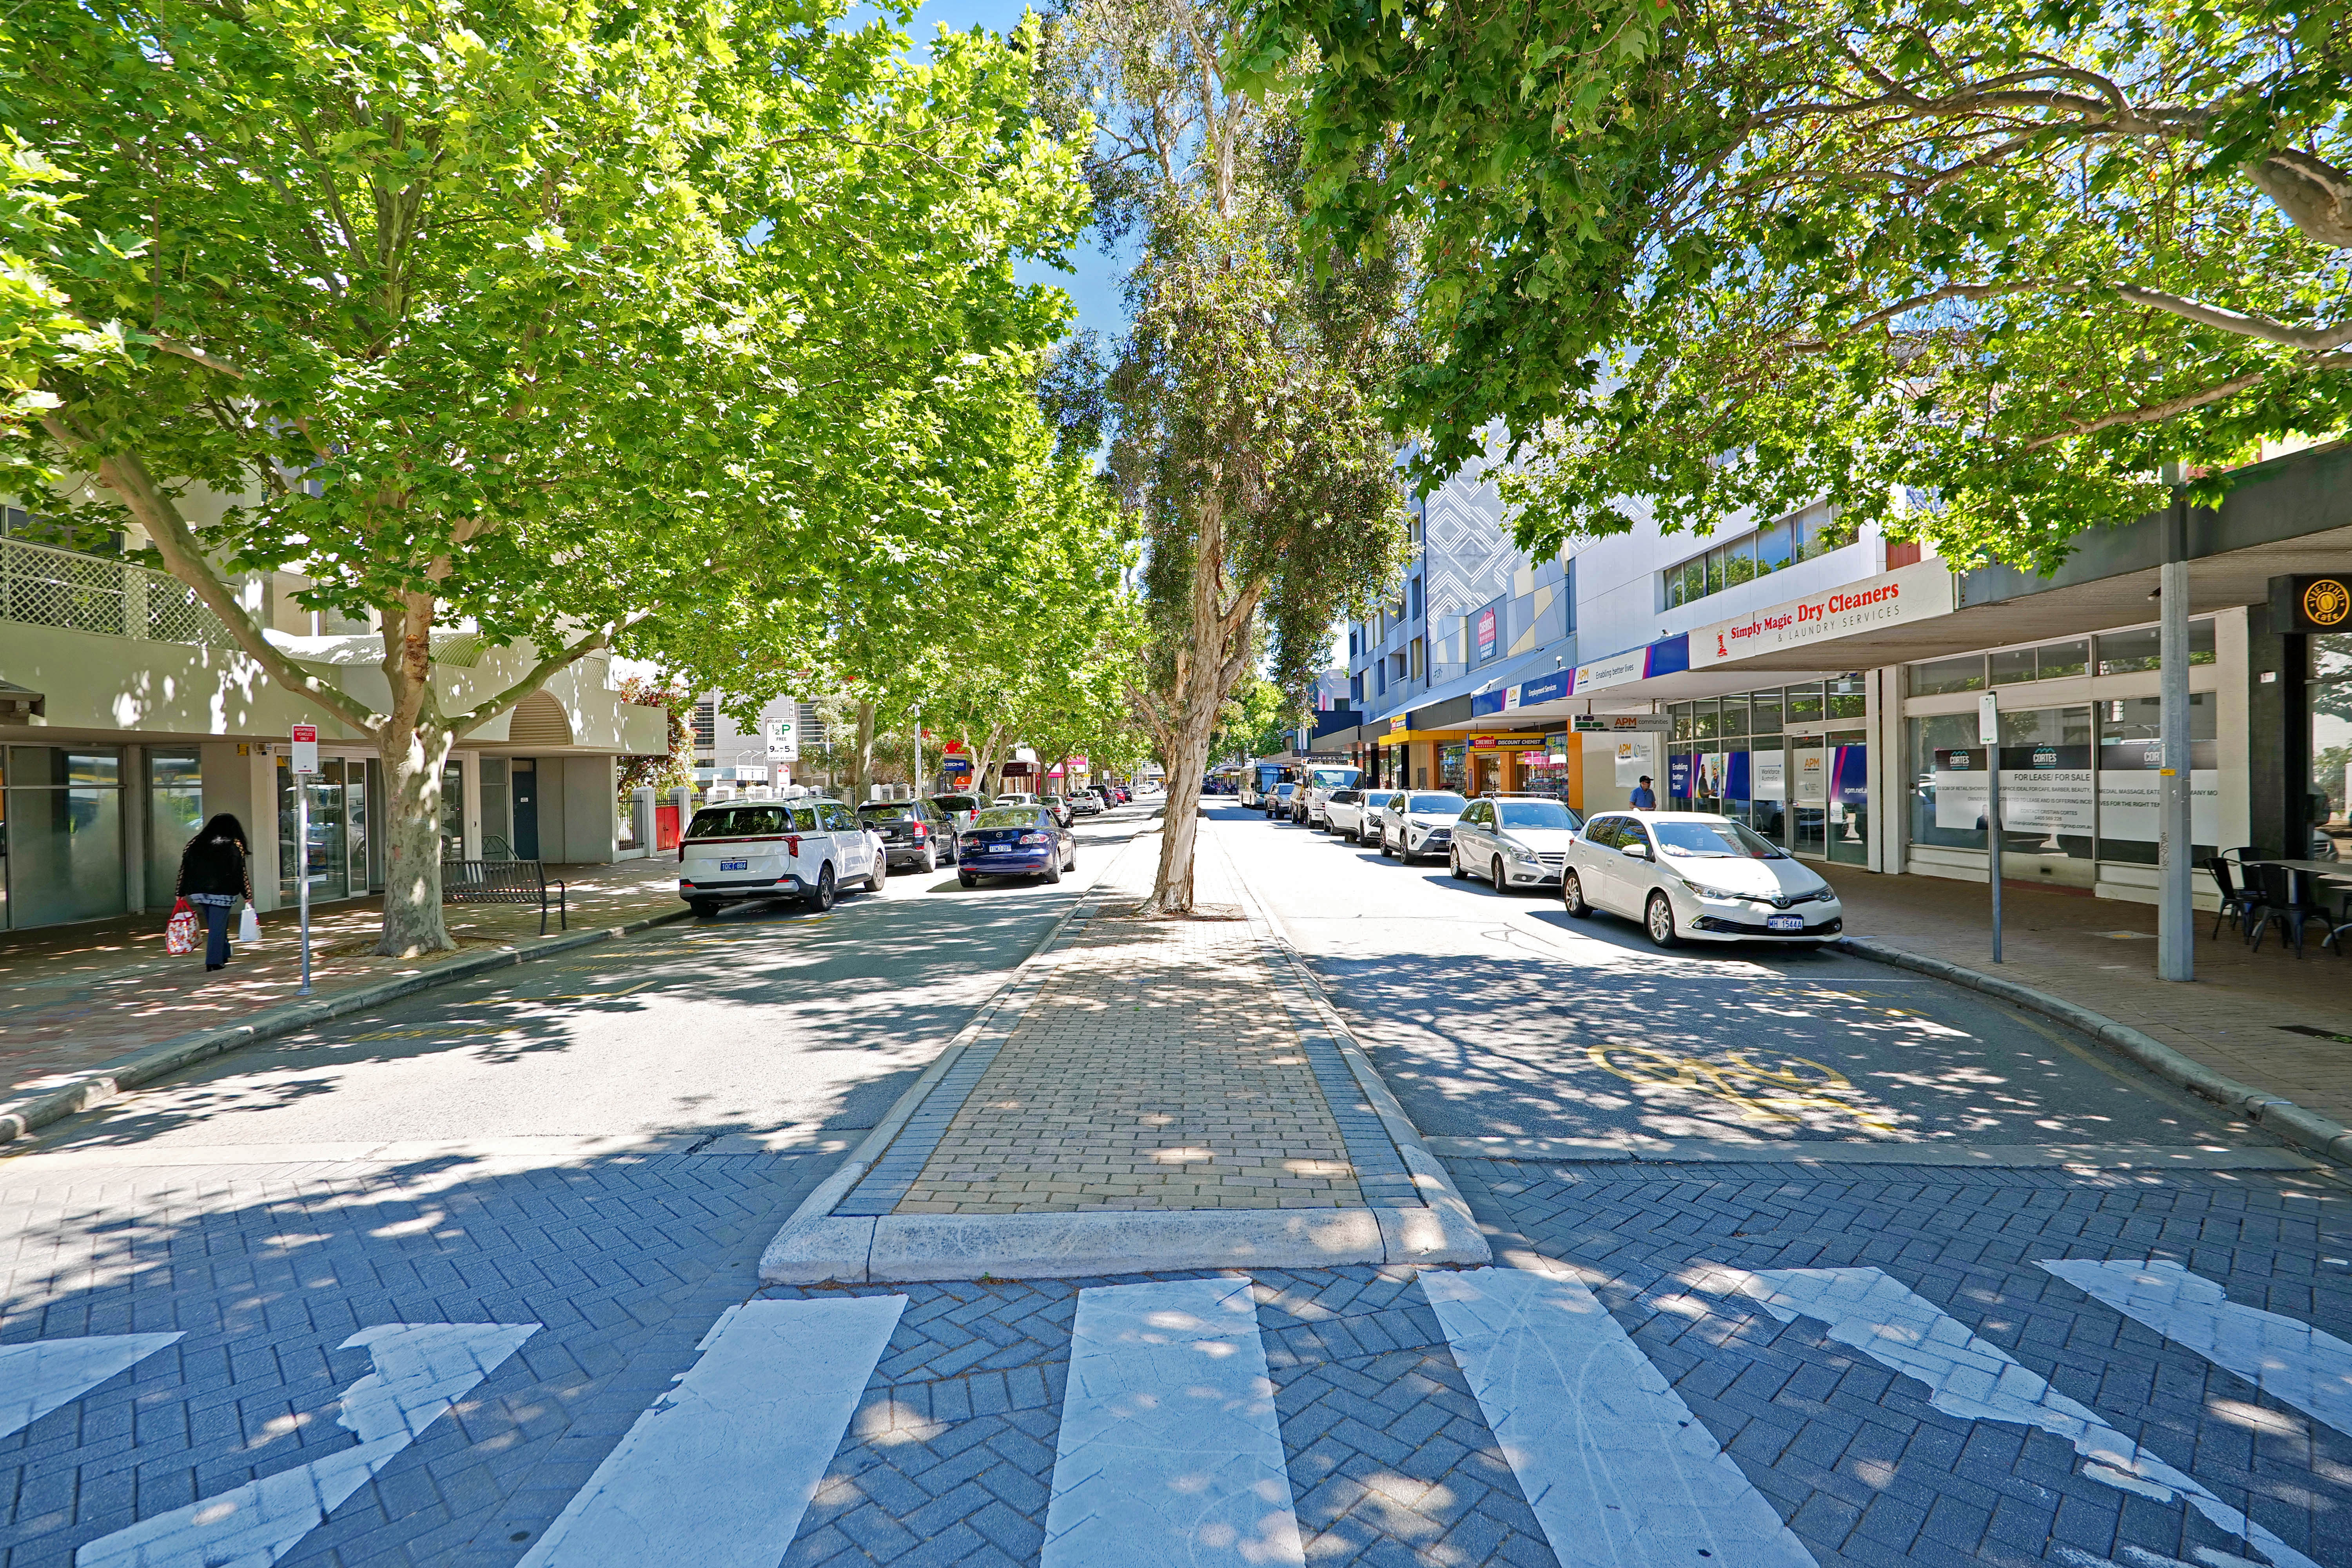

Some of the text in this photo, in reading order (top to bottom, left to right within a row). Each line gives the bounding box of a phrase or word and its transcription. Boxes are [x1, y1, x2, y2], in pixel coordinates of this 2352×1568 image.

[1731, 583, 1899, 639] Simply Magic Dry Cleaners
[2314, 611, 2340, 622] Cafe
[1479, 616, 1494, 635] CHEMIST
[1778, 605, 1899, 642] & LAUNDRY SERVICES
[1480, 641, 1494, 652] DISCOUNT
[1481, 649, 1493, 659] CHEMIST
[1577, 668, 1589, 681] APM
[1596, 663, 1634, 679] Enabling better lives
[1528, 684, 1557, 698] Employment Services
[1615, 717, 1637, 726] APM
[1618, 743, 1631, 755] APM
[1805, 758, 1820, 768] APM
[1950, 756, 1970, 764] CORTES
[2033, 753, 2057, 762] CORTES
[1672, 763, 1688, 771] Enabling
[1769, 920, 1802, 928] MH 1544A
